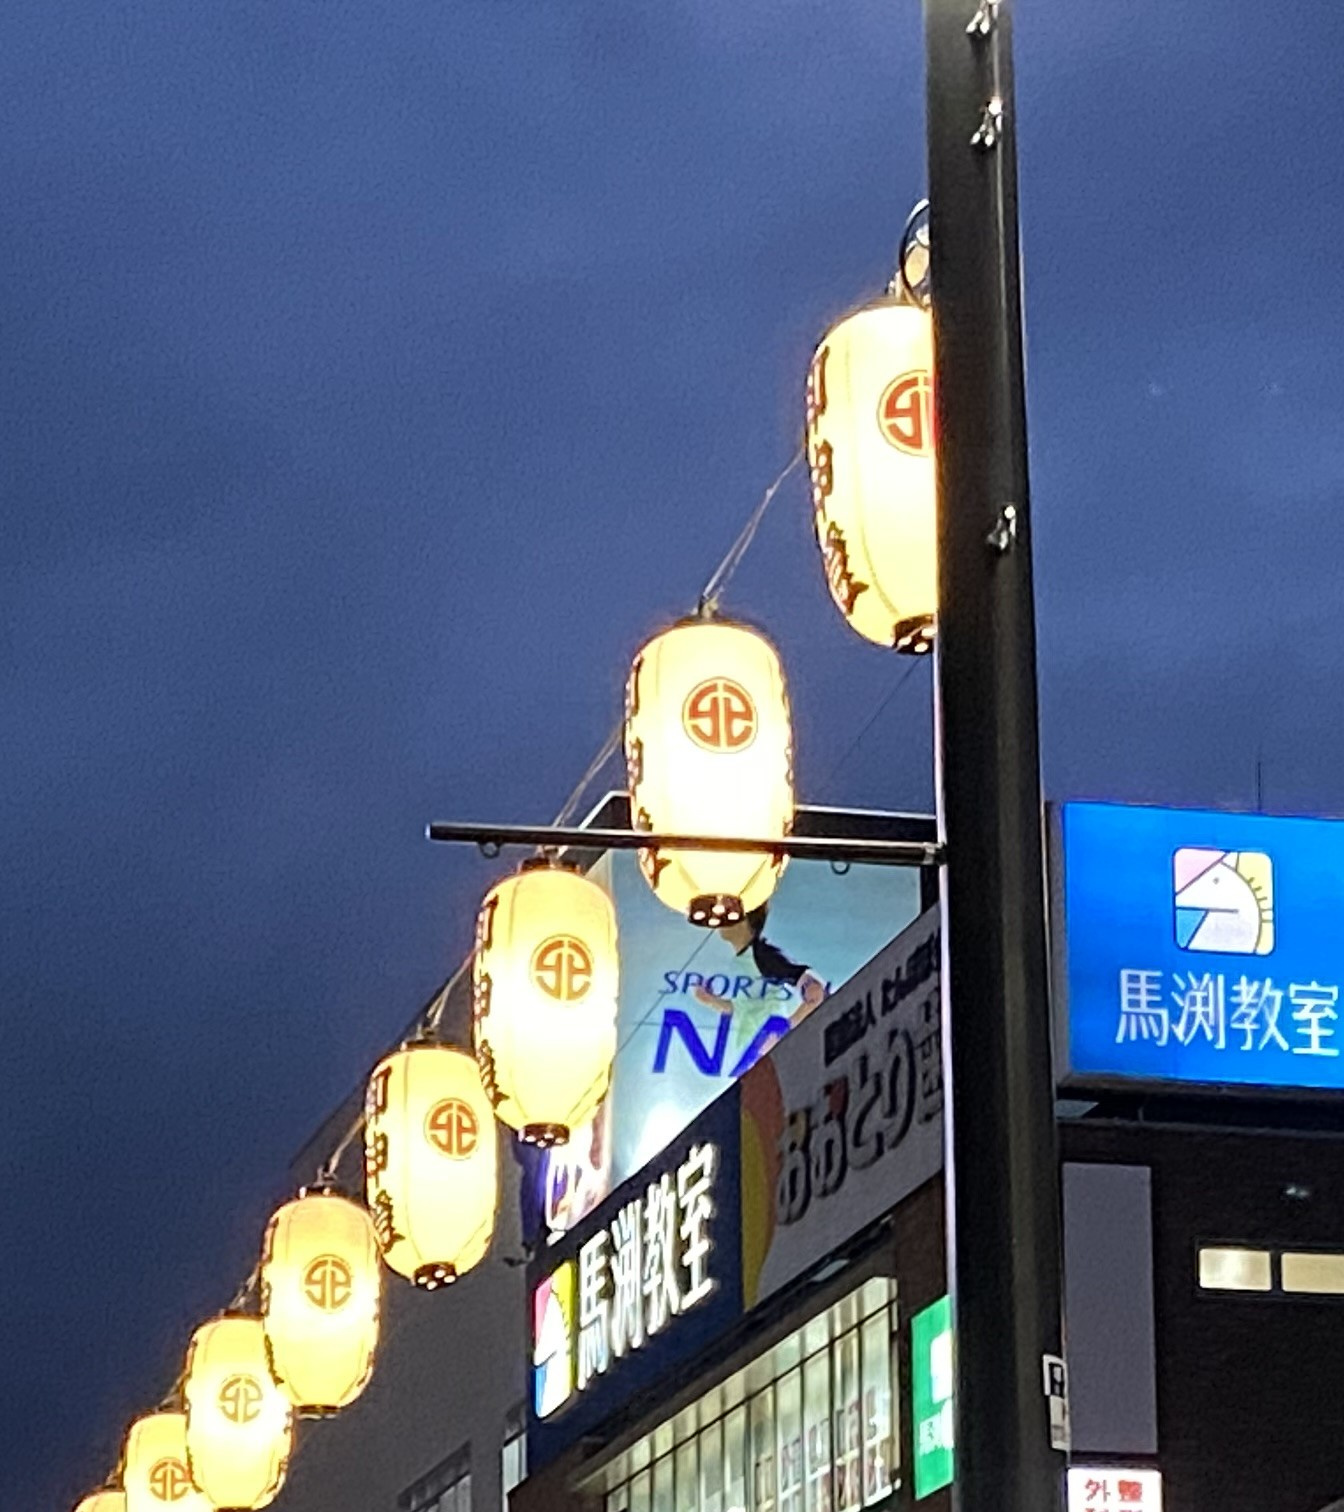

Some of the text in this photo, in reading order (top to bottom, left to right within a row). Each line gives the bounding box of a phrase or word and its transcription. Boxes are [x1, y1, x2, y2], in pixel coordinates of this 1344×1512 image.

[1115, 967, 1341, 1057] 馬渕教室
[577, 1142, 717, 1391] 馬渕教室
